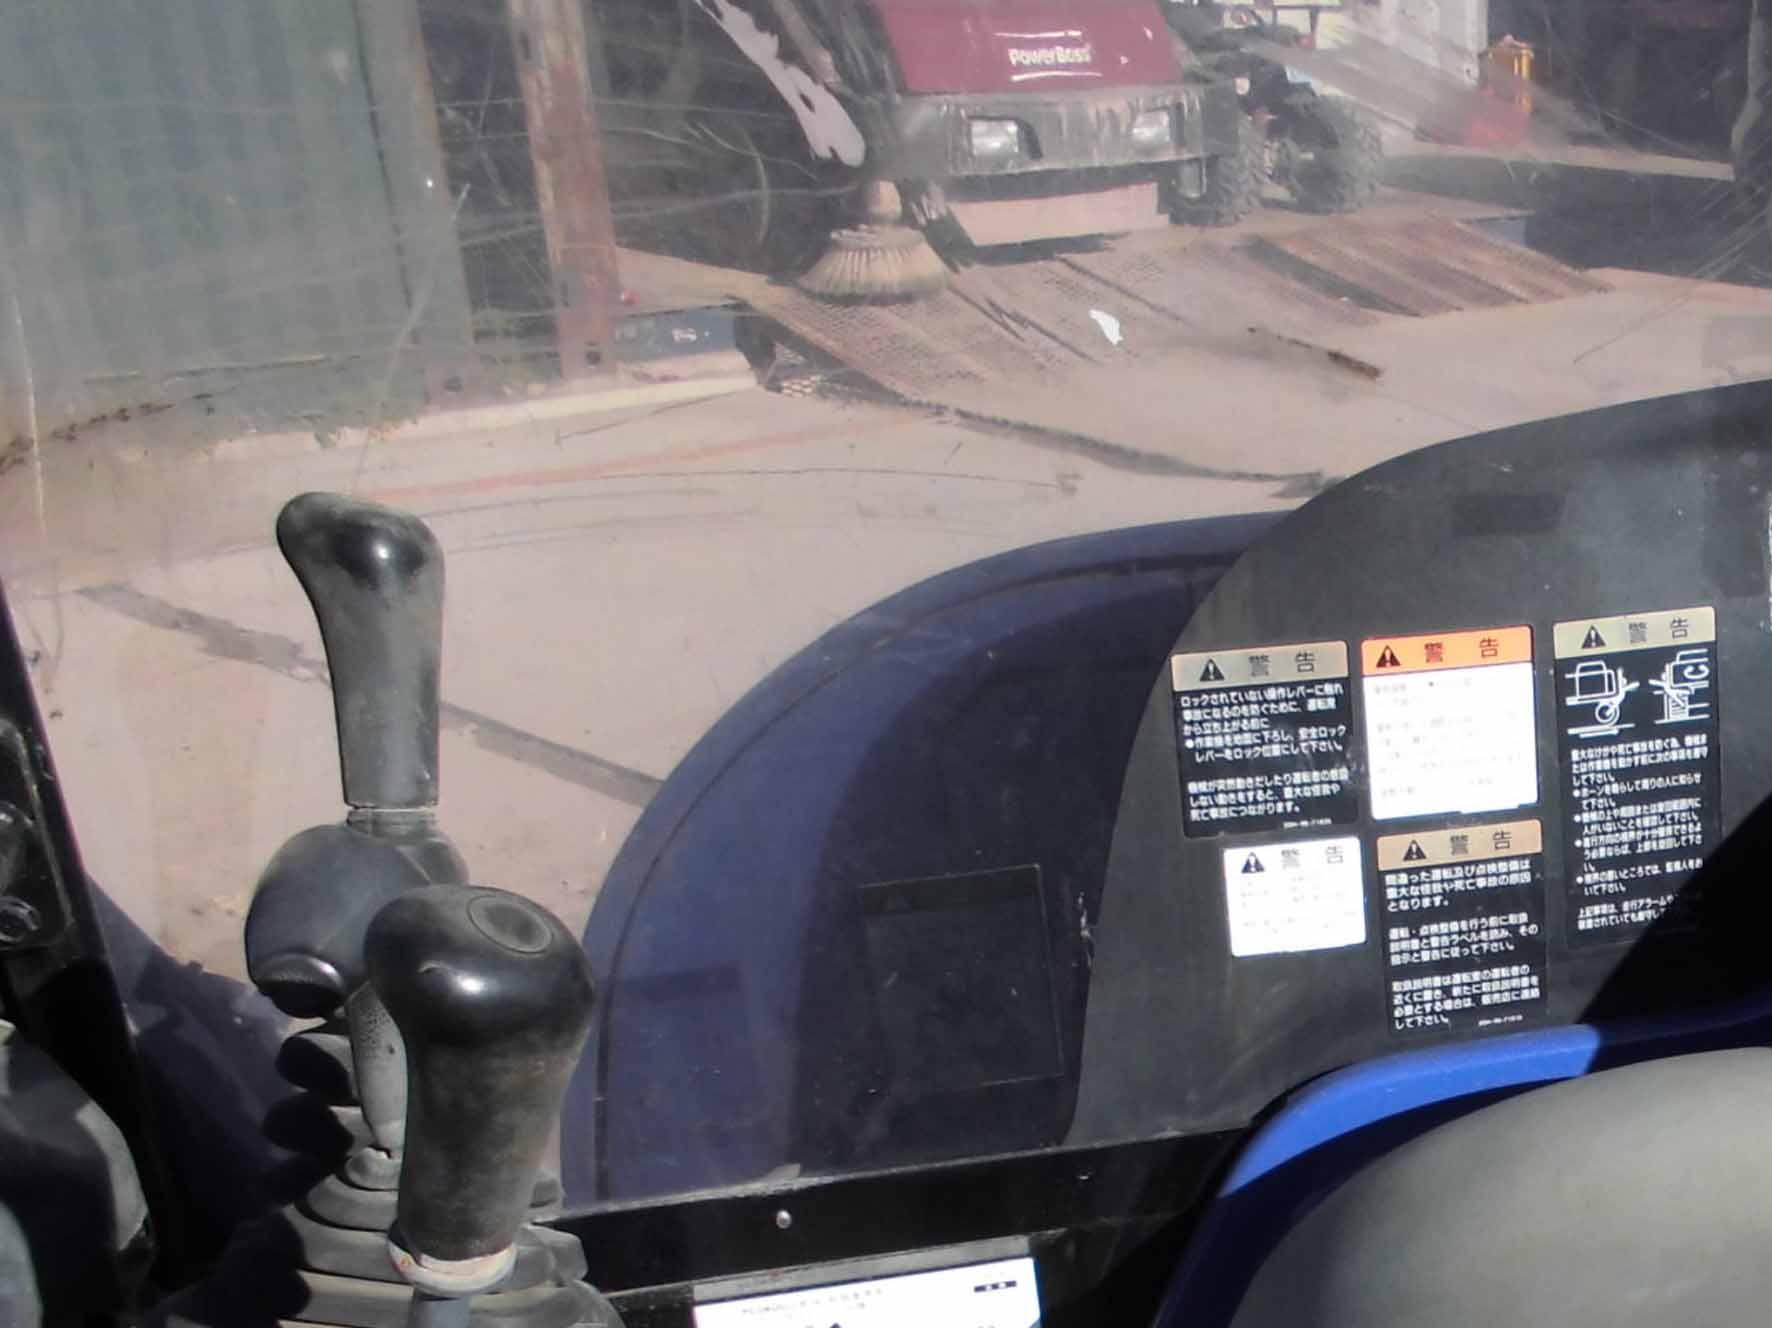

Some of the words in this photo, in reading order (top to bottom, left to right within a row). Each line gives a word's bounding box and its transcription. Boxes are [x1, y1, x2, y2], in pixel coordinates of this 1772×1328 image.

[1627, 617, 1689, 645] 警告
[1424, 638, 1500, 664] 警告
[1248, 652, 1316, 678] 警告
[1450, 830, 1514, 857] 警告
[1387, 895, 1448, 912] となります。
